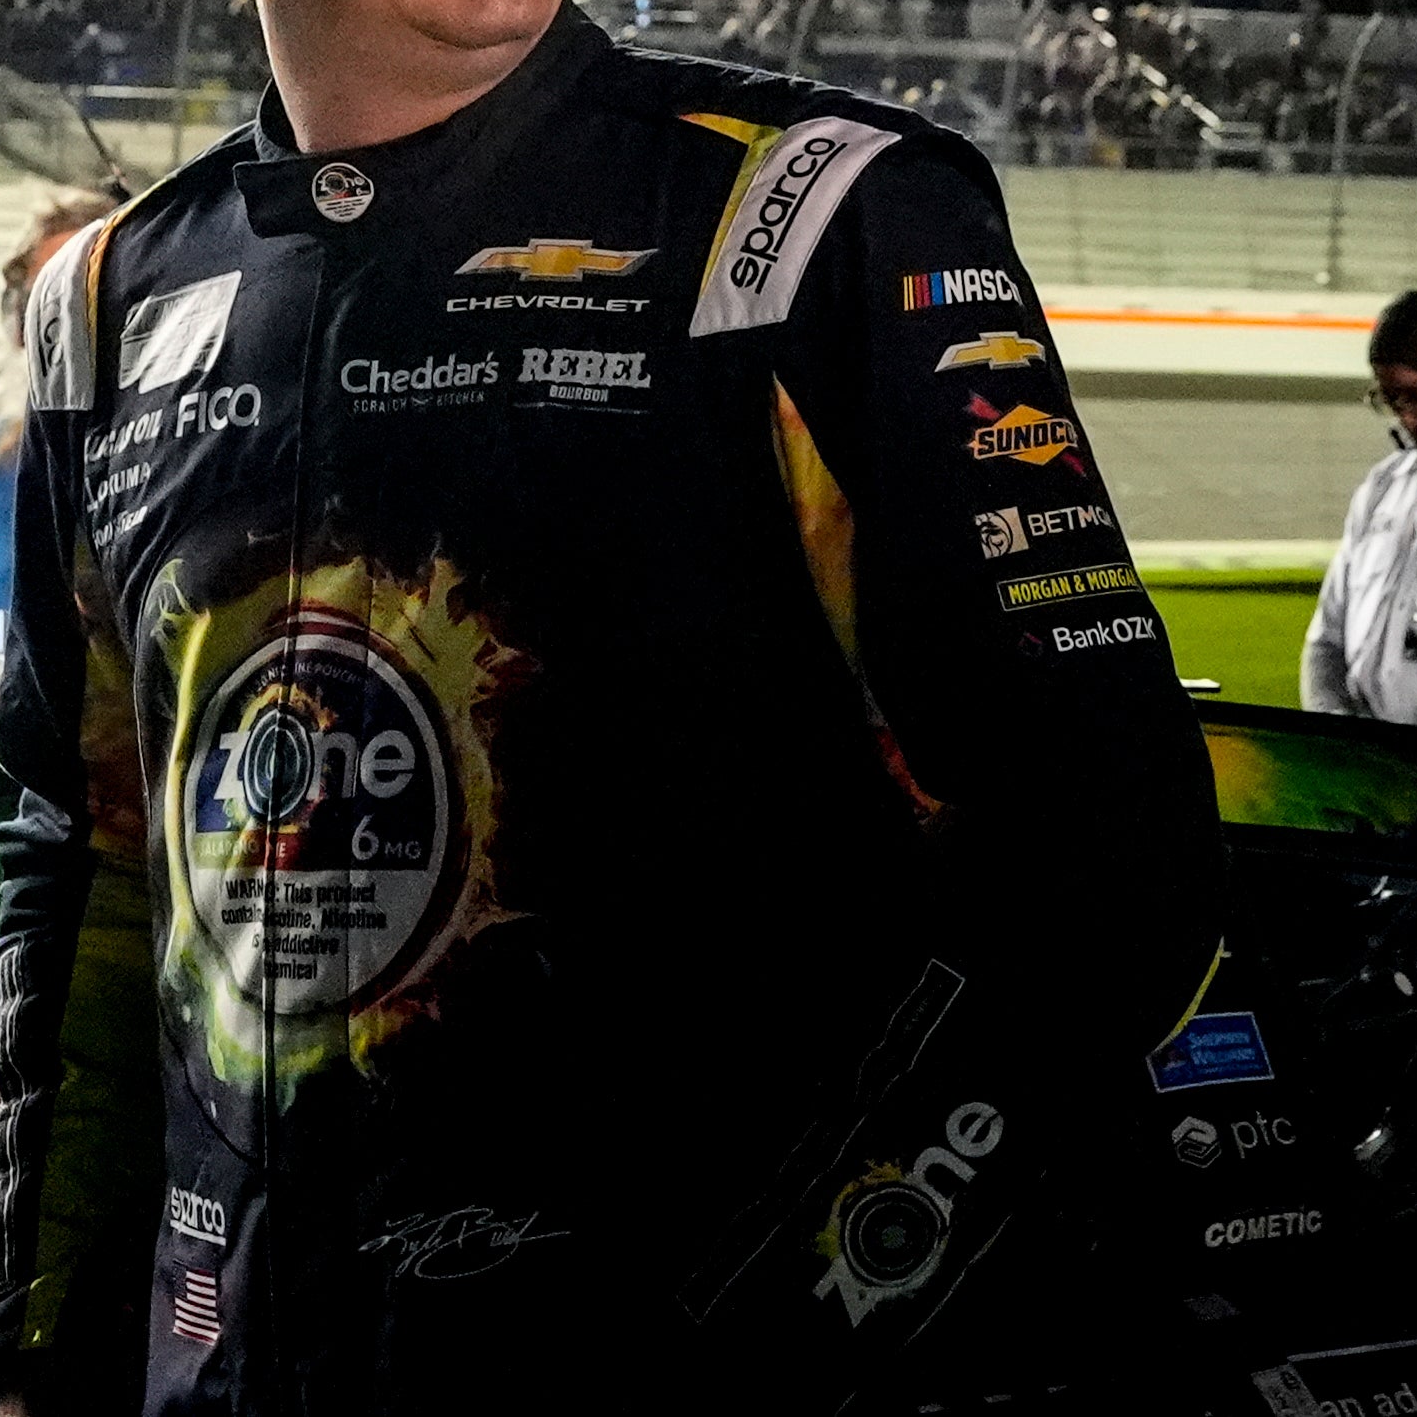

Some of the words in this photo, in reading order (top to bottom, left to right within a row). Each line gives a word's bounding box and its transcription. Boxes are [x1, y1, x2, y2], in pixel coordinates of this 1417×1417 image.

[730, 138, 845, 294] sparco
[446, 294, 650, 313] CHEVROLET
[943, 268, 1023, 306] NASC
[341, 351, 500, 394] Cheddar's
[518, 347, 652, 389] REBEL
[549, 384, 609, 404] BOURBON
[1007, 576, 1072, 605] MORGAN
[1074, 574, 1087, 594] &
[1052, 616, 1157, 652] BankOZK
[212, 709, 417, 819] zone
[351, 814, 380, 862] 6
[384, 840, 423, 860] MG
[1230, 1110, 1297, 1160] ptc
[170, 1186, 226, 1237] sparco
[1204, 1209, 1323, 1249] COMETIC
